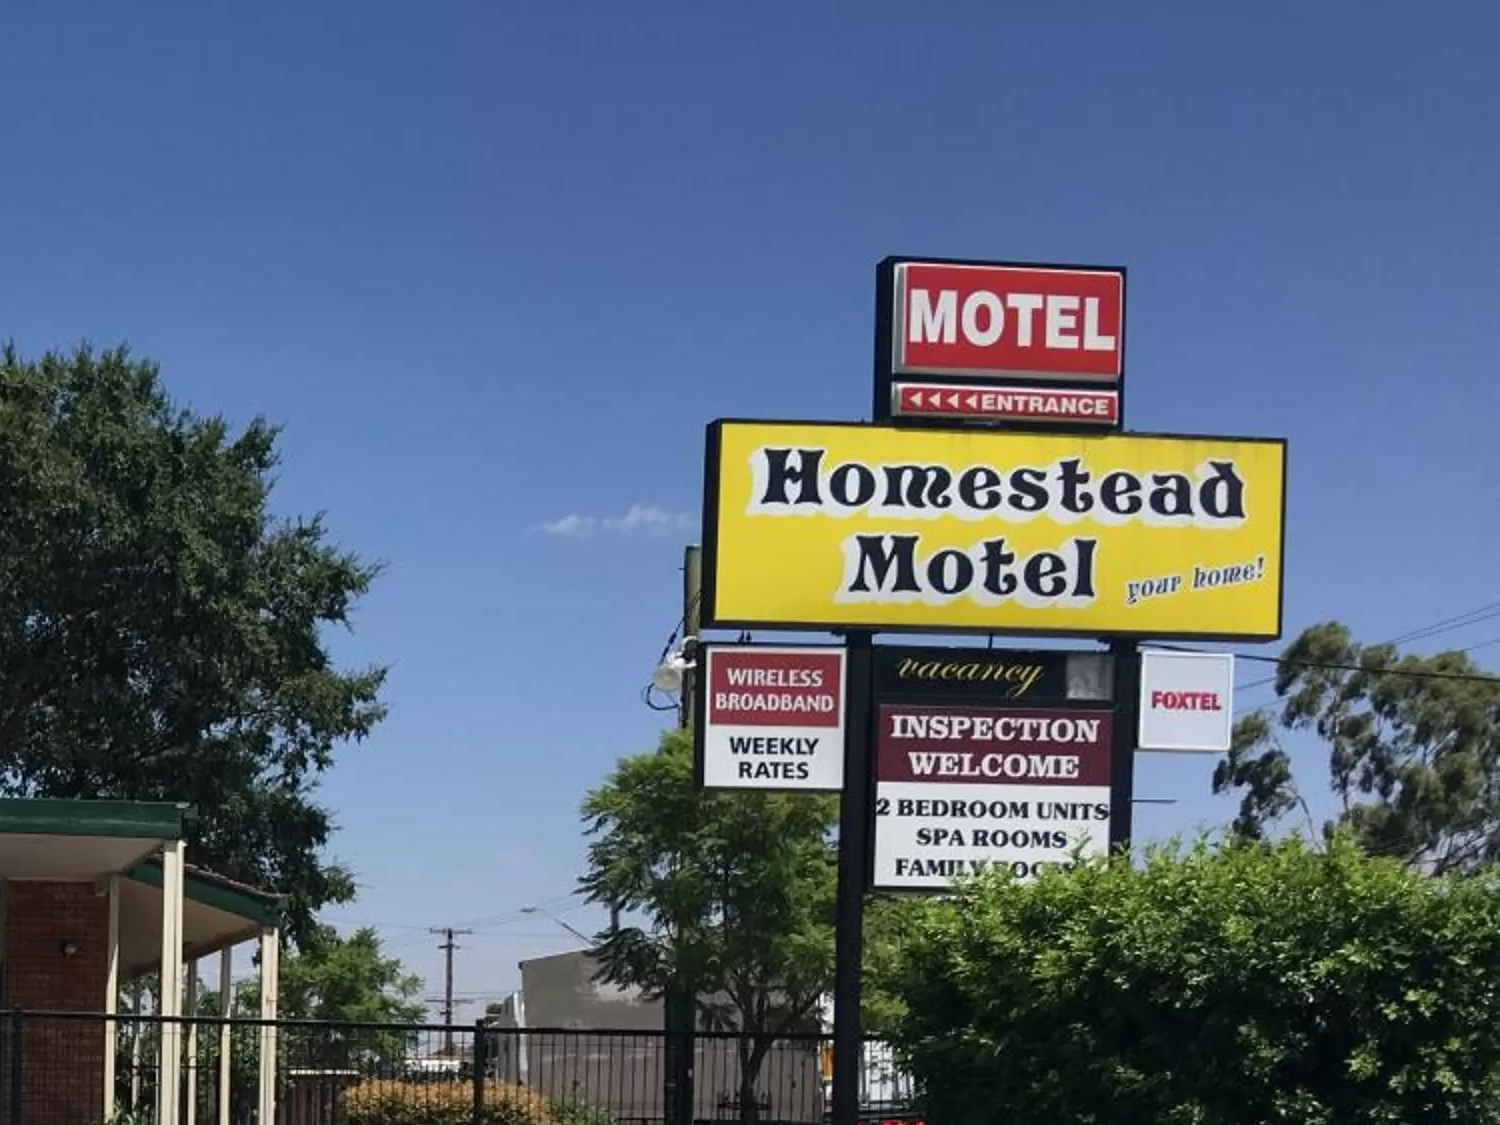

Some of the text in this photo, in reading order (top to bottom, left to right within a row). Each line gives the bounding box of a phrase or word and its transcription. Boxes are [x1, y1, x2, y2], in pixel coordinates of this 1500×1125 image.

[909, 288, 1116, 351] MOTEL
[981, 393, 1109, 415] ENTRANCE
[759, 447, 1246, 520] Homestead
[847, 534, 1097, 598] Motel
[1126, 557, 1264, 605] your home!
[726, 667, 824, 687] WIRELESS
[897, 657, 1044, 697] vacancy
[714, 692, 835, 713] BROADBAND
[1151, 691, 1222, 711] FOXTEL
[890, 715, 1101, 743] INSPECTION
[729, 737, 820, 755] WEEKLY
[738, 761, 809, 780] RATES
[908, 751, 1080, 779] WELCOME
[875, 798, 1110, 822] 2 BEDROOM UNITS
[915, 828, 1068, 849] SPA ROOMS
